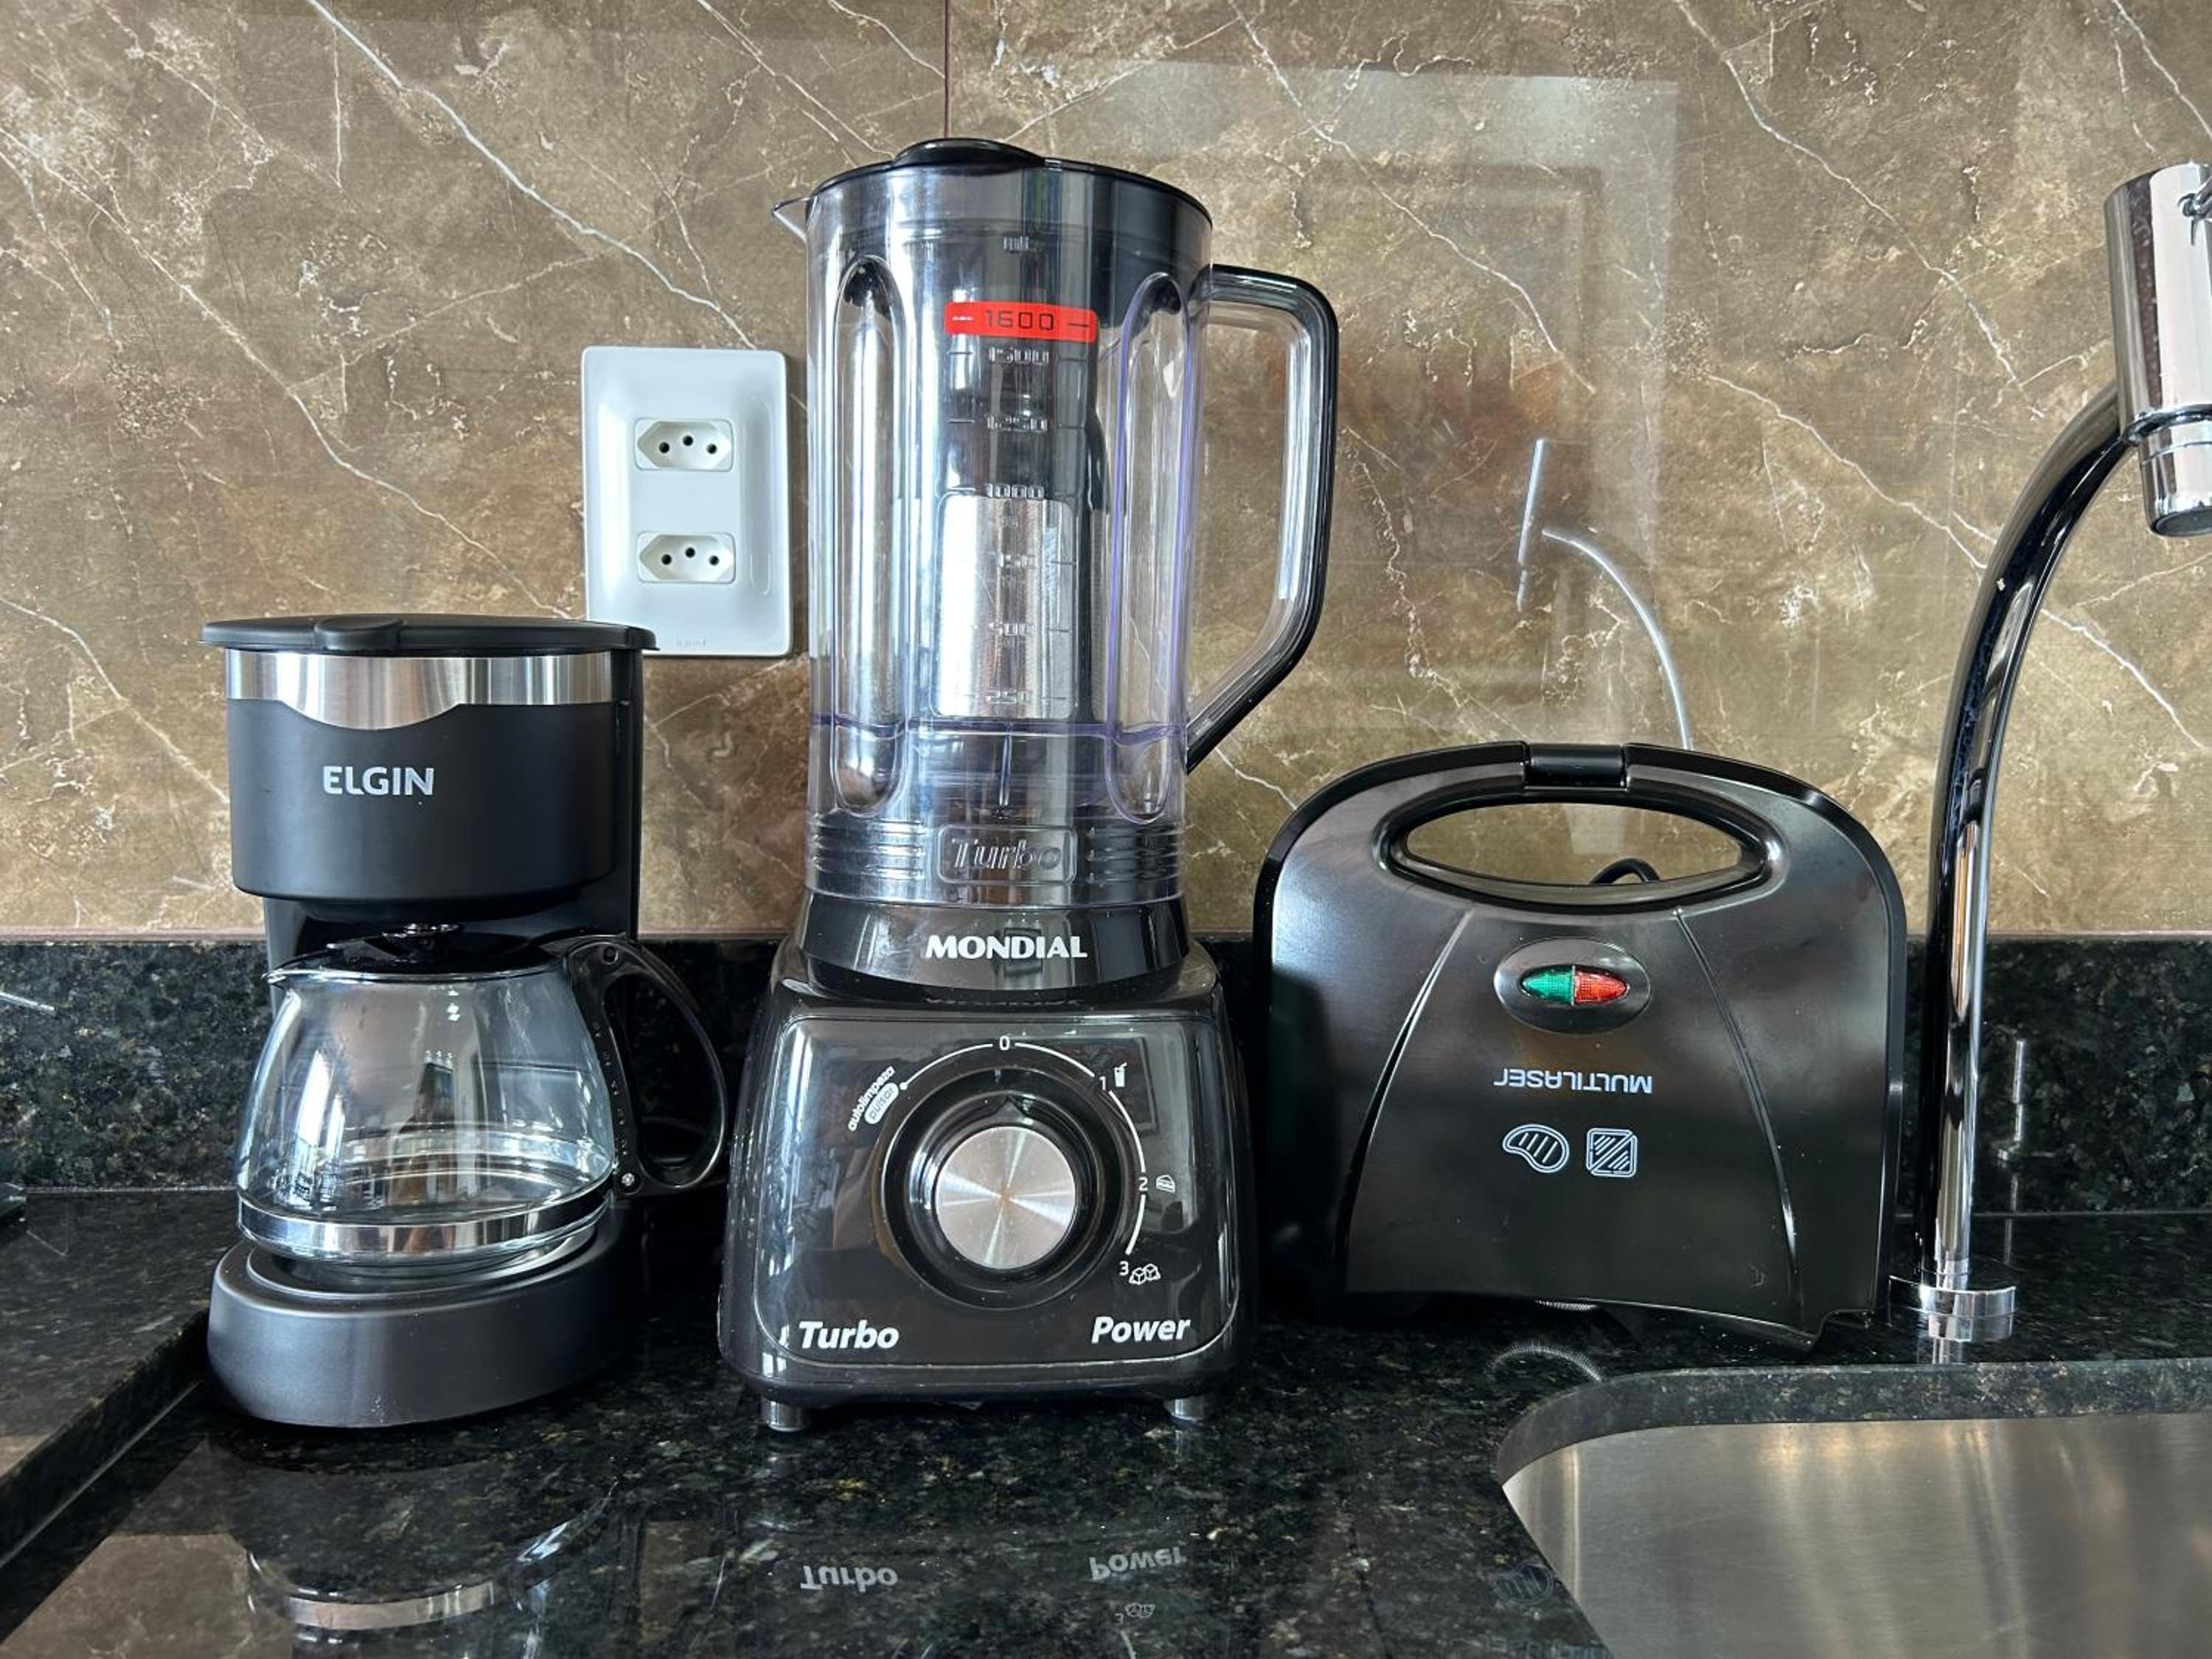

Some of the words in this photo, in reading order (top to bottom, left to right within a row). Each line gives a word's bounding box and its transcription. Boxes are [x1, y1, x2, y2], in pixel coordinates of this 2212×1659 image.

[985, 310, 1054, 331] 1600
[989, 347, 1049, 365] 1500
[984, 483, 1045, 499] 1000
[322, 765, 434, 796] ELGIN
[952, 838, 1061, 870] Turbo
[925, 935, 1088, 959] MONDIAL
[999, 1035, 1010, 1051] 0
[1099, 1077, 1106, 1091] 1
[1493, 1068, 1652, 1093] MULTILASER
[847, 1065, 896, 1132] autolimpeza
[1138, 1177, 1148, 1191] 2
[1119, 1261, 1129, 1276] 3
[798, 1321, 900, 1349] Turbo
[1091, 1316, 1191, 1344] Power
